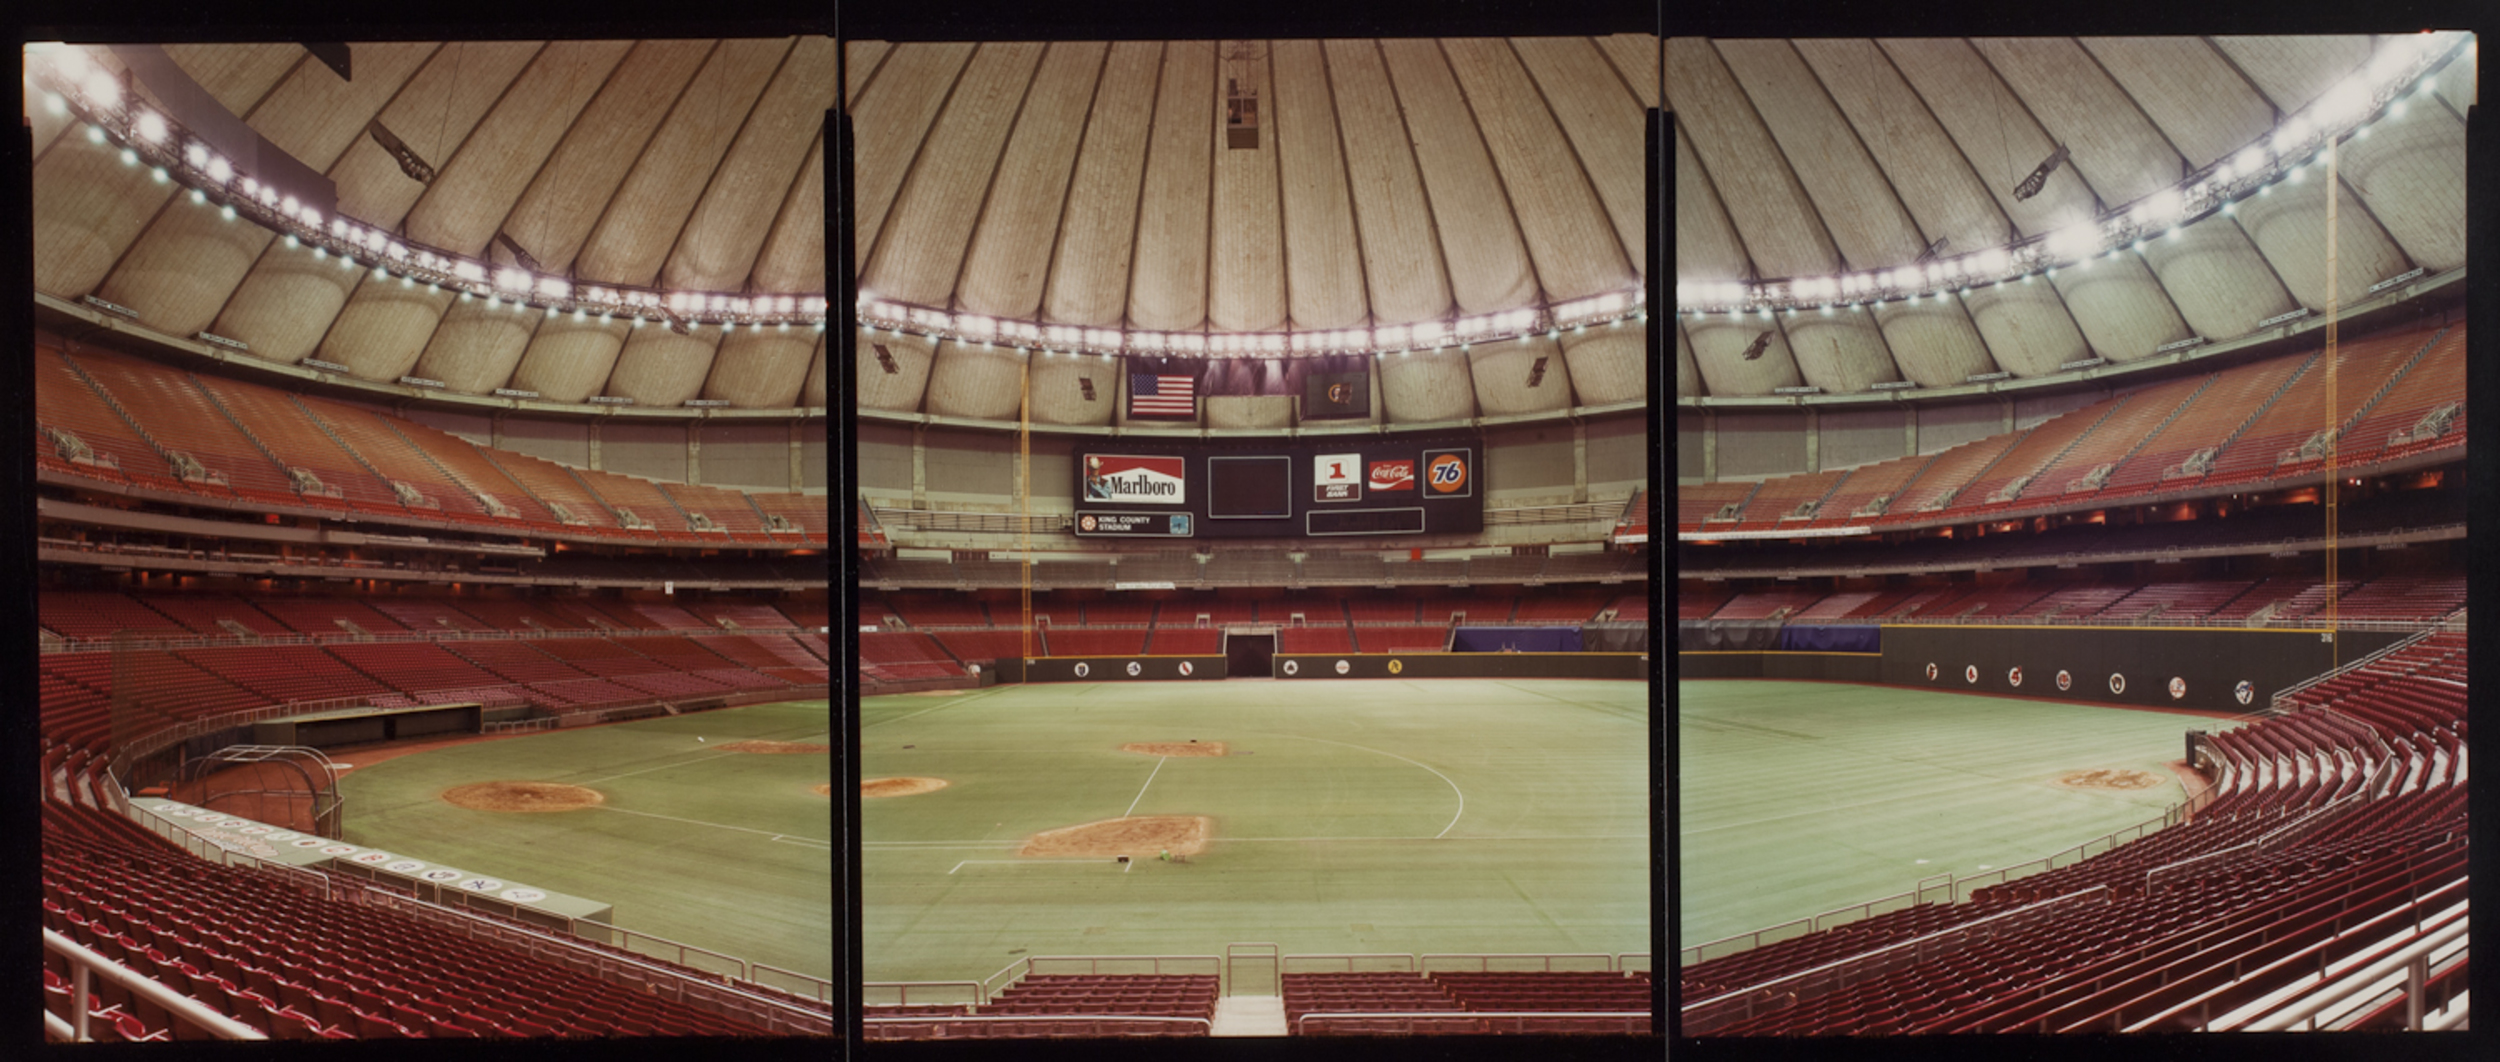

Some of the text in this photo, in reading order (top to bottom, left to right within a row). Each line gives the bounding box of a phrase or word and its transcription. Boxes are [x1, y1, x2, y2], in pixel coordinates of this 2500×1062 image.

[1330, 463, 1346, 479] 1
[1433, 461, 1461, 483] 76
[1111, 475, 1175, 495] Marlboro
[1098, 523, 1132, 531] STADIUM
[1119, 516, 1151, 524] COUNTY
